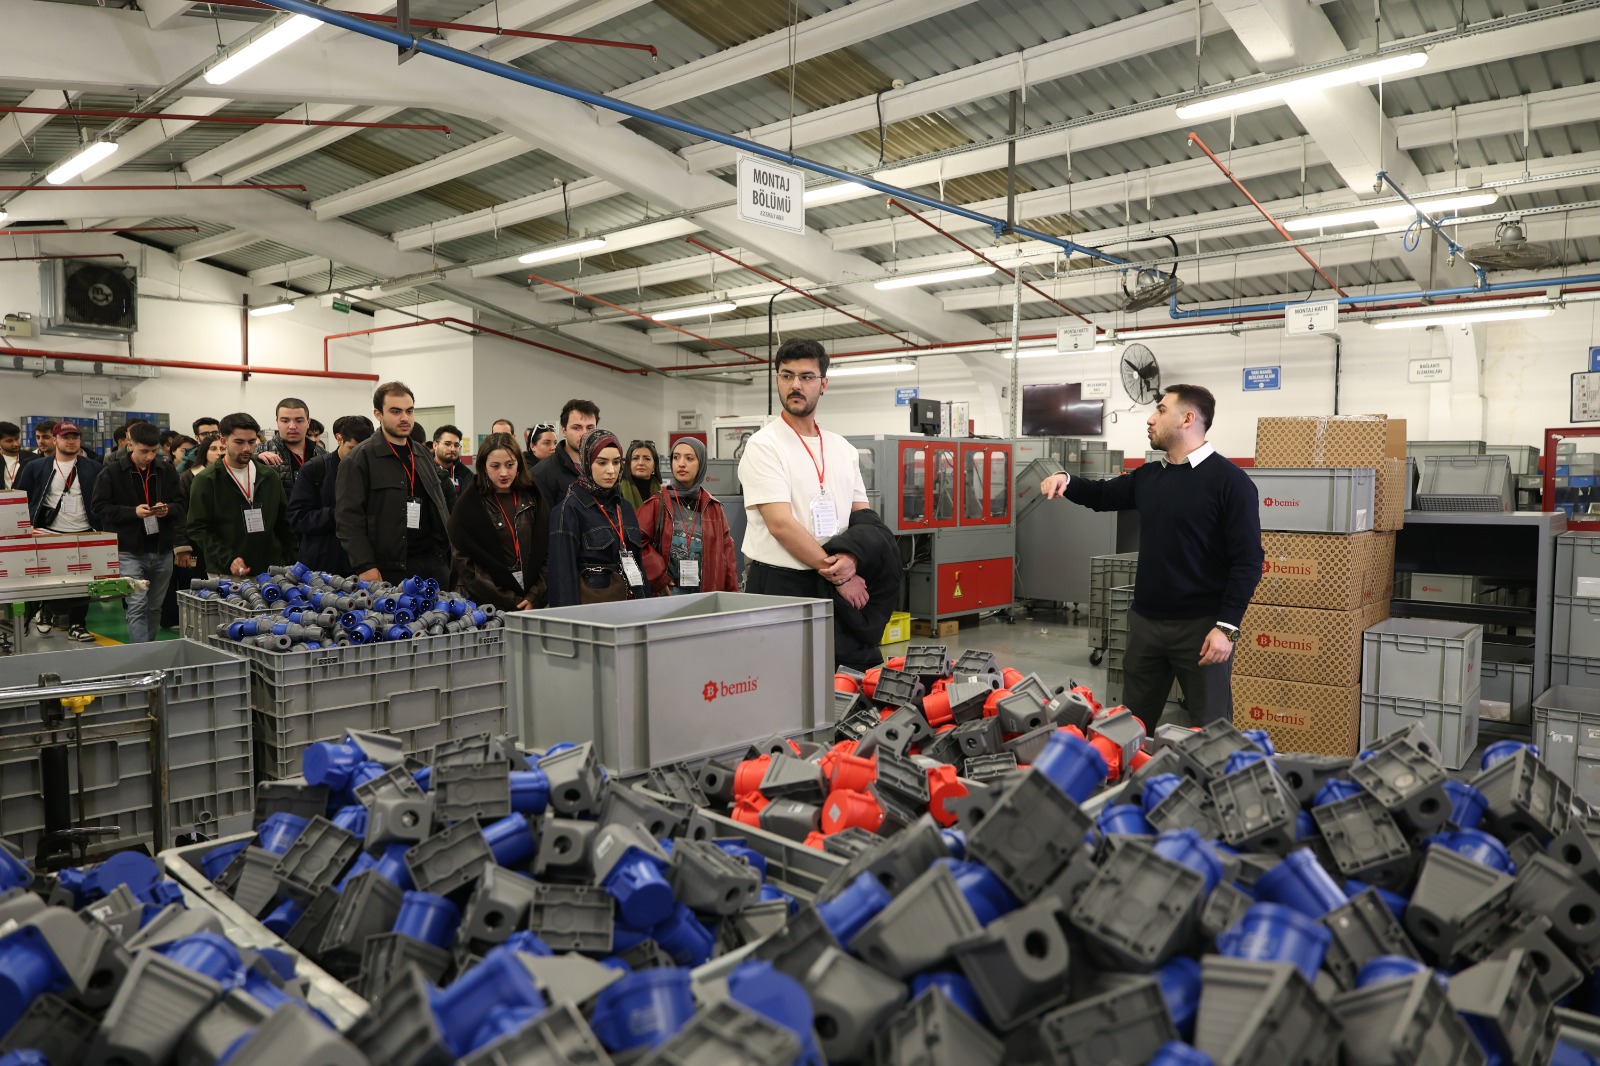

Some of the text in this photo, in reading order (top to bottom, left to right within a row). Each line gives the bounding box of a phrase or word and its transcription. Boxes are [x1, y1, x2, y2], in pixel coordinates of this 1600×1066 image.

[753, 168, 790, 192] MONTAJ
[752, 189, 791, 213] BÖLÜMÜ
[1274, 498, 1300, 507] bemis
[1273, 562, 1312, 575] bemis
[1273, 635, 1312, 651] bemis
[720, 675, 758, 697] bemis
[1266, 709, 1305, 726] bemis
